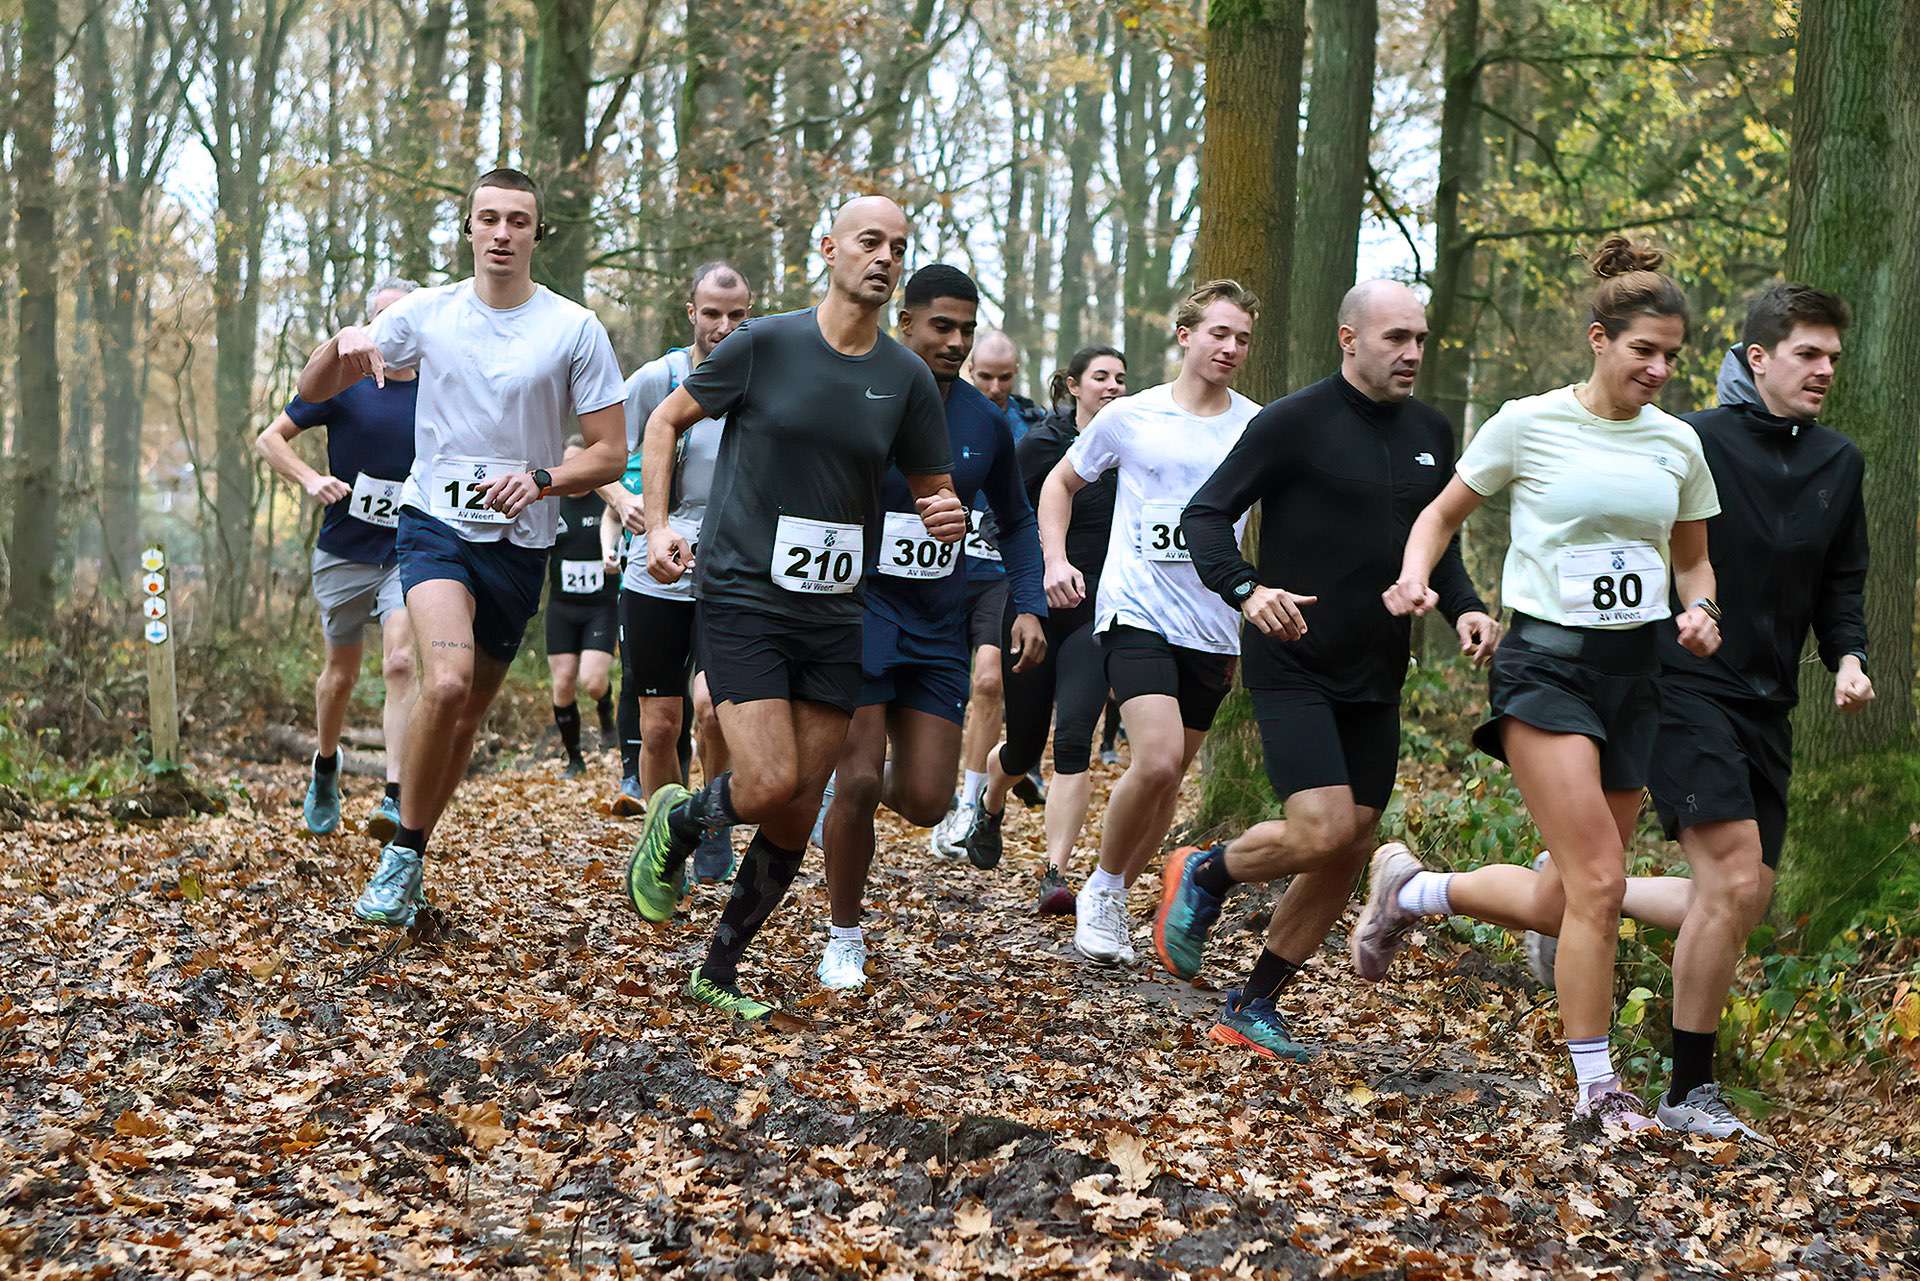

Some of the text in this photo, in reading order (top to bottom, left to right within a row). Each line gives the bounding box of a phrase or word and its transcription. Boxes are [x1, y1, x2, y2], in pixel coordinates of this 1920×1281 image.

[444, 480, 491, 511] 12
[1152, 524, 1188, 550] 30
[784, 546, 852, 583] 210
[892, 539, 954, 568] 308
[567, 573, 597, 587] 211
[801, 581, 813, 590] AV
[1593, 573, 1642, 610] 80
